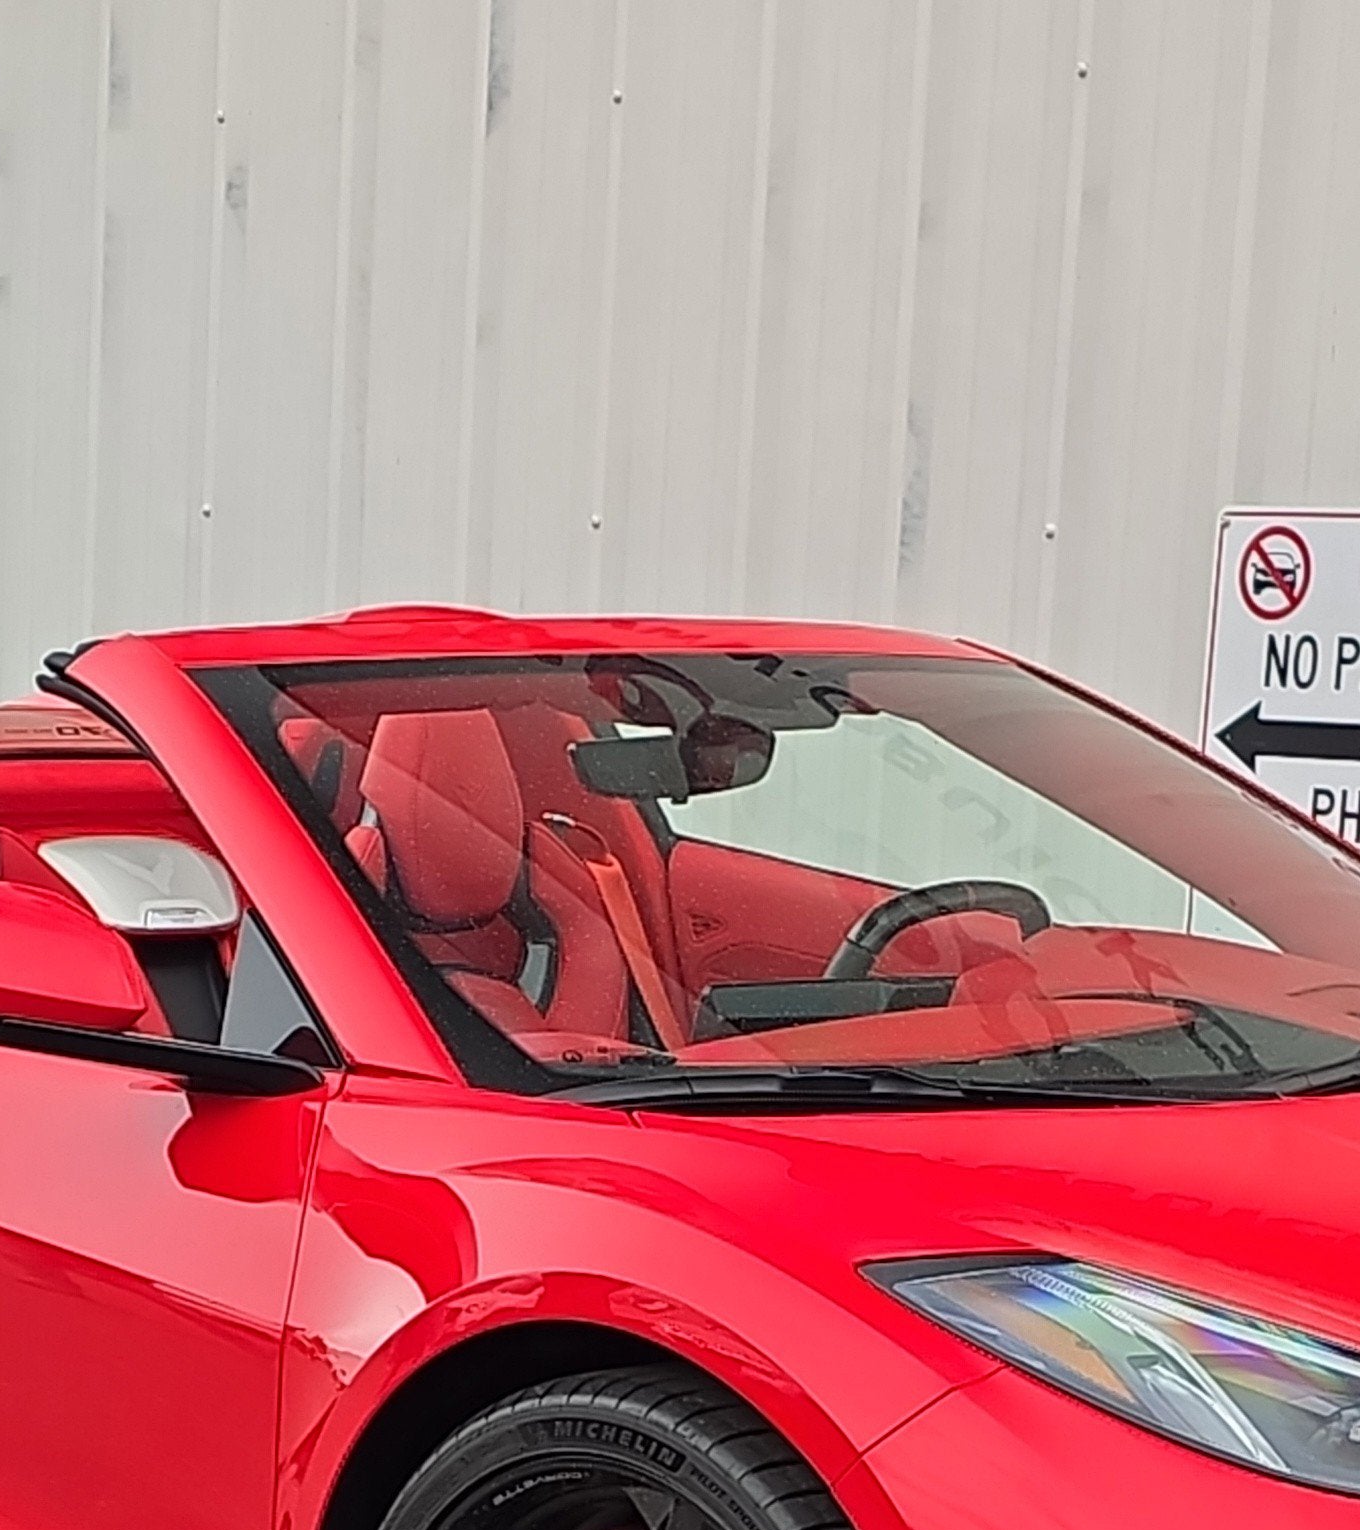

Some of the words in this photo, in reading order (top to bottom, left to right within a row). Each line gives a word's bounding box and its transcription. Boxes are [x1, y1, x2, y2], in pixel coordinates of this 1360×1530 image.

[1264, 634, 1319, 689] NO
[554, 1420, 677, 1467] MICHELIN
[690, 1464, 727, 1499] PILOT
